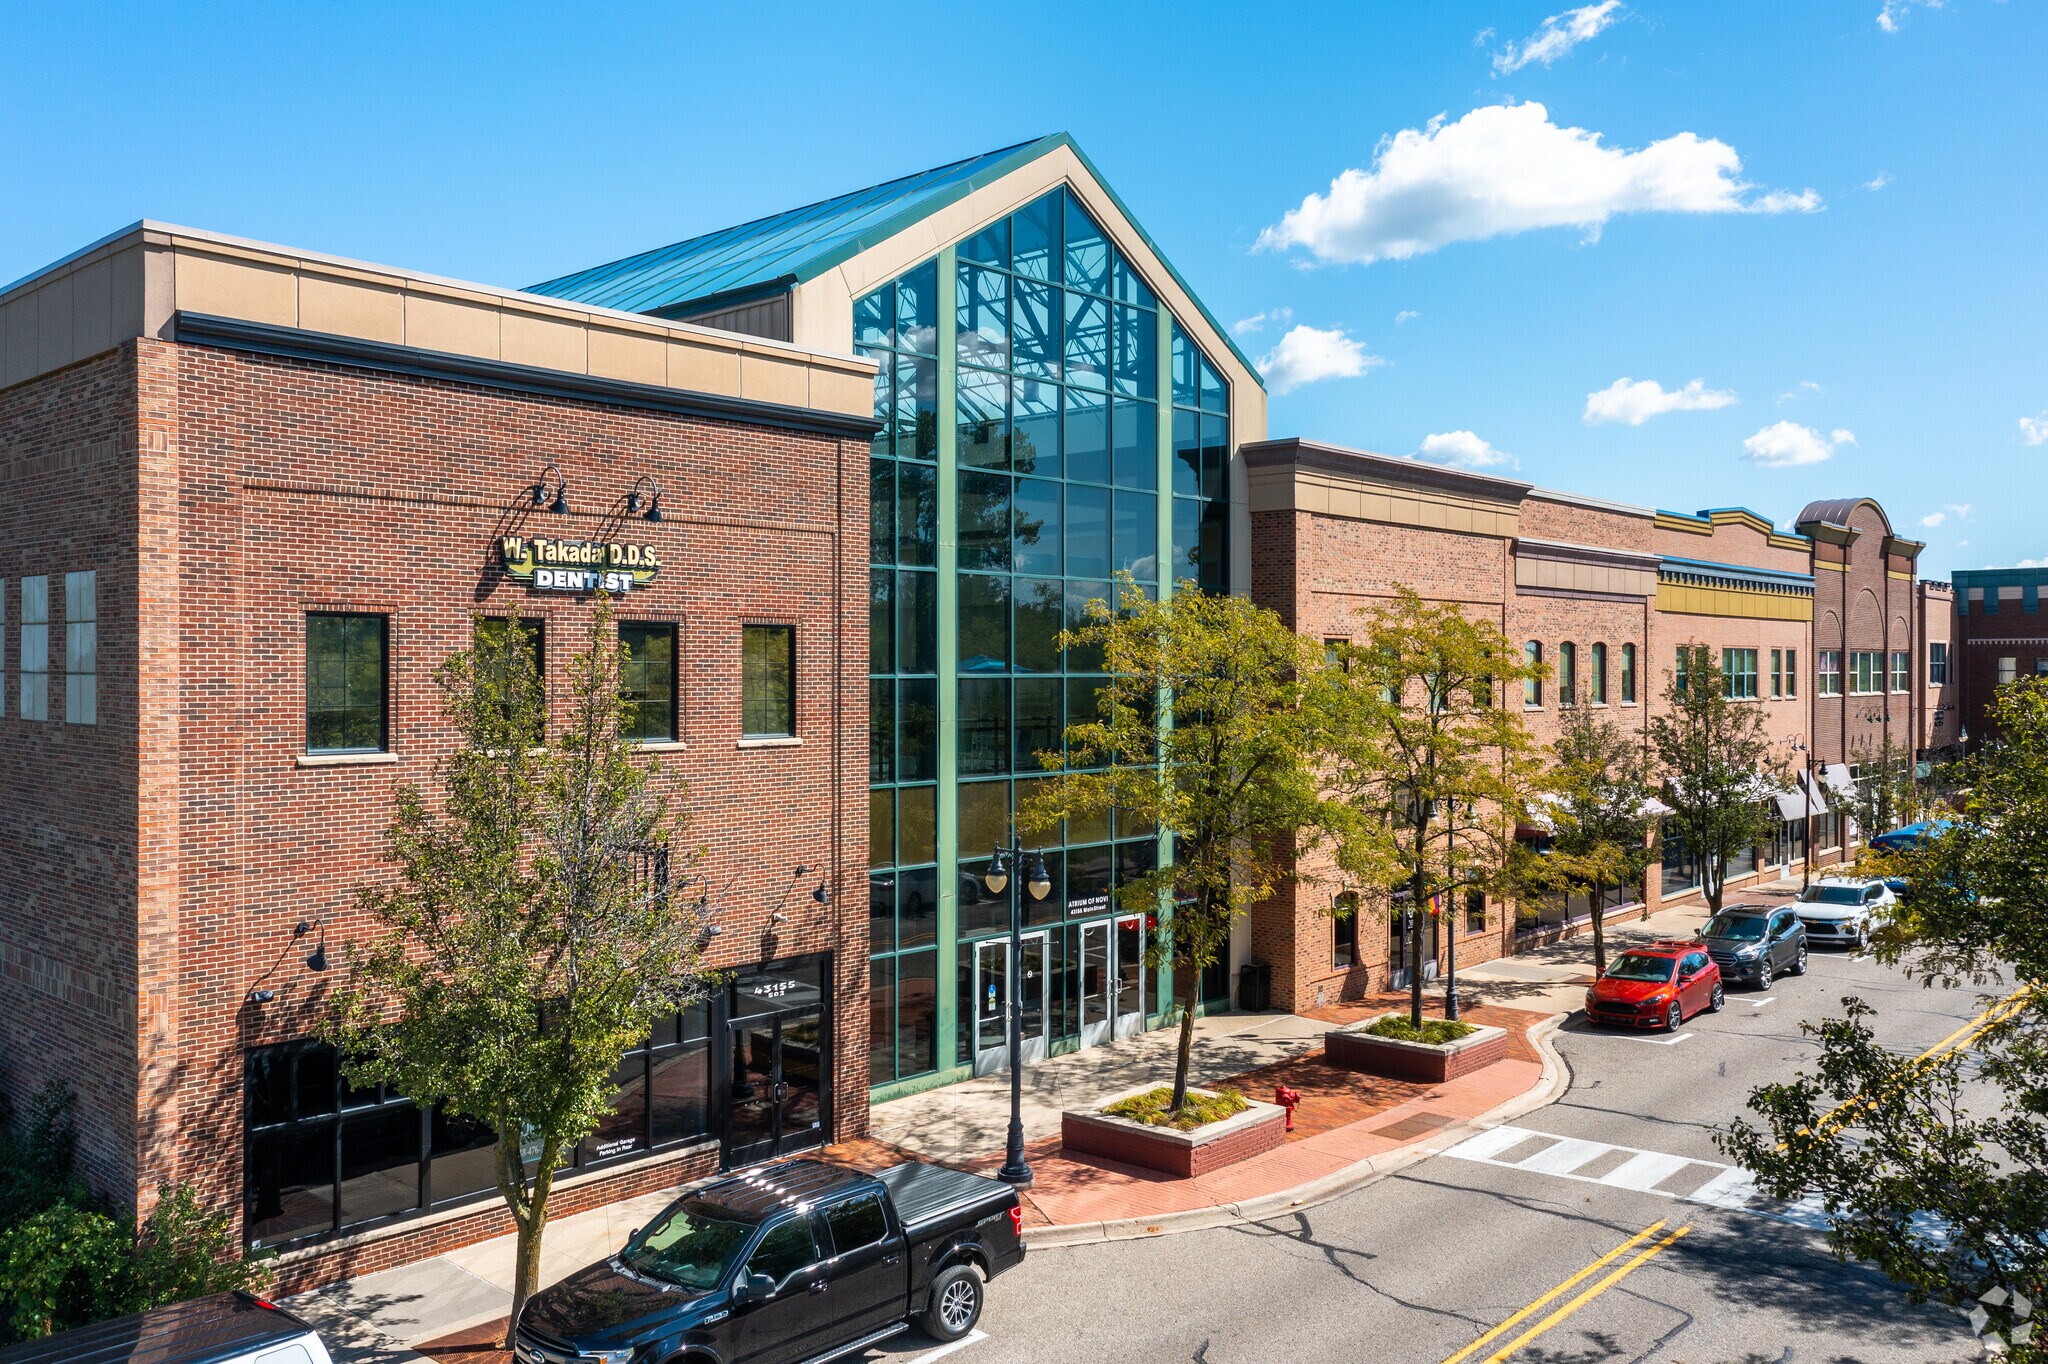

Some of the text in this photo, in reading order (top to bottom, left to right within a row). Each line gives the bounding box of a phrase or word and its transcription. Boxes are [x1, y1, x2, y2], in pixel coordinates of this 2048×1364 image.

[503, 537, 661, 566] W. Takada D.D.S.
[1068, 895, 1109, 908] ATRIUM OF NOVI
[754, 980, 796, 994] 43155
[768, 990, 785, 998] 502
[596, 1137, 636, 1150] Additional Garage
[599, 1148, 616, 1156] Parking
